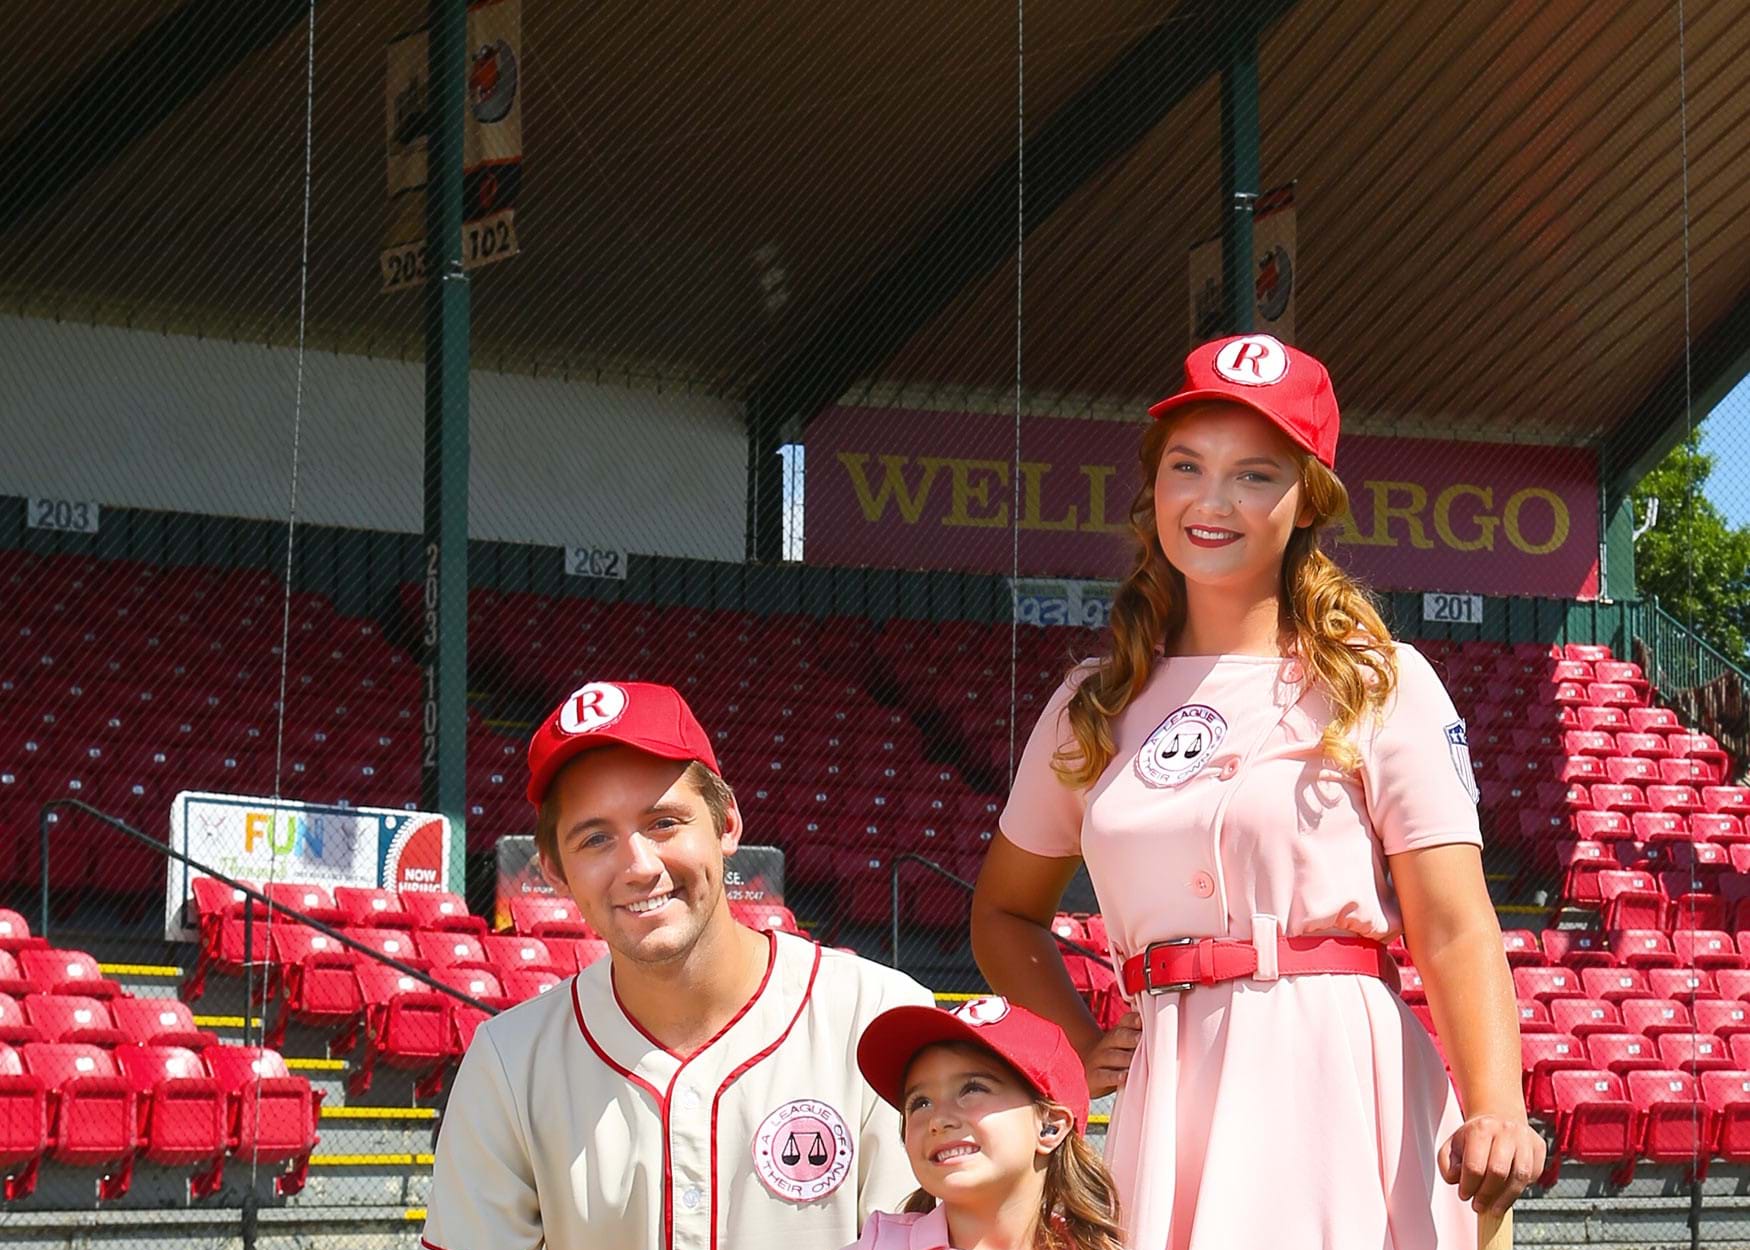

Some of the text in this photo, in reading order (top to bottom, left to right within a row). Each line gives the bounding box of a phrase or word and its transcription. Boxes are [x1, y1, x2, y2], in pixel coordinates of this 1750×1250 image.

[469, 219, 510, 260] 102
[1228, 342, 1263, 378] R
[38, 499, 89, 530] 203
[1434, 595, 1473, 622] 201
[423, 543, 438, 768] 203 102
[572, 690, 610, 728] R
[1163, 709, 1217, 732] LEAGUE
[245, 812, 324, 858] FUN
[405, 868, 437, 882] NOW
[762, 1104, 847, 1147] A LEAGUE OF
[763, 1161, 845, 1196] THEIR OWN
